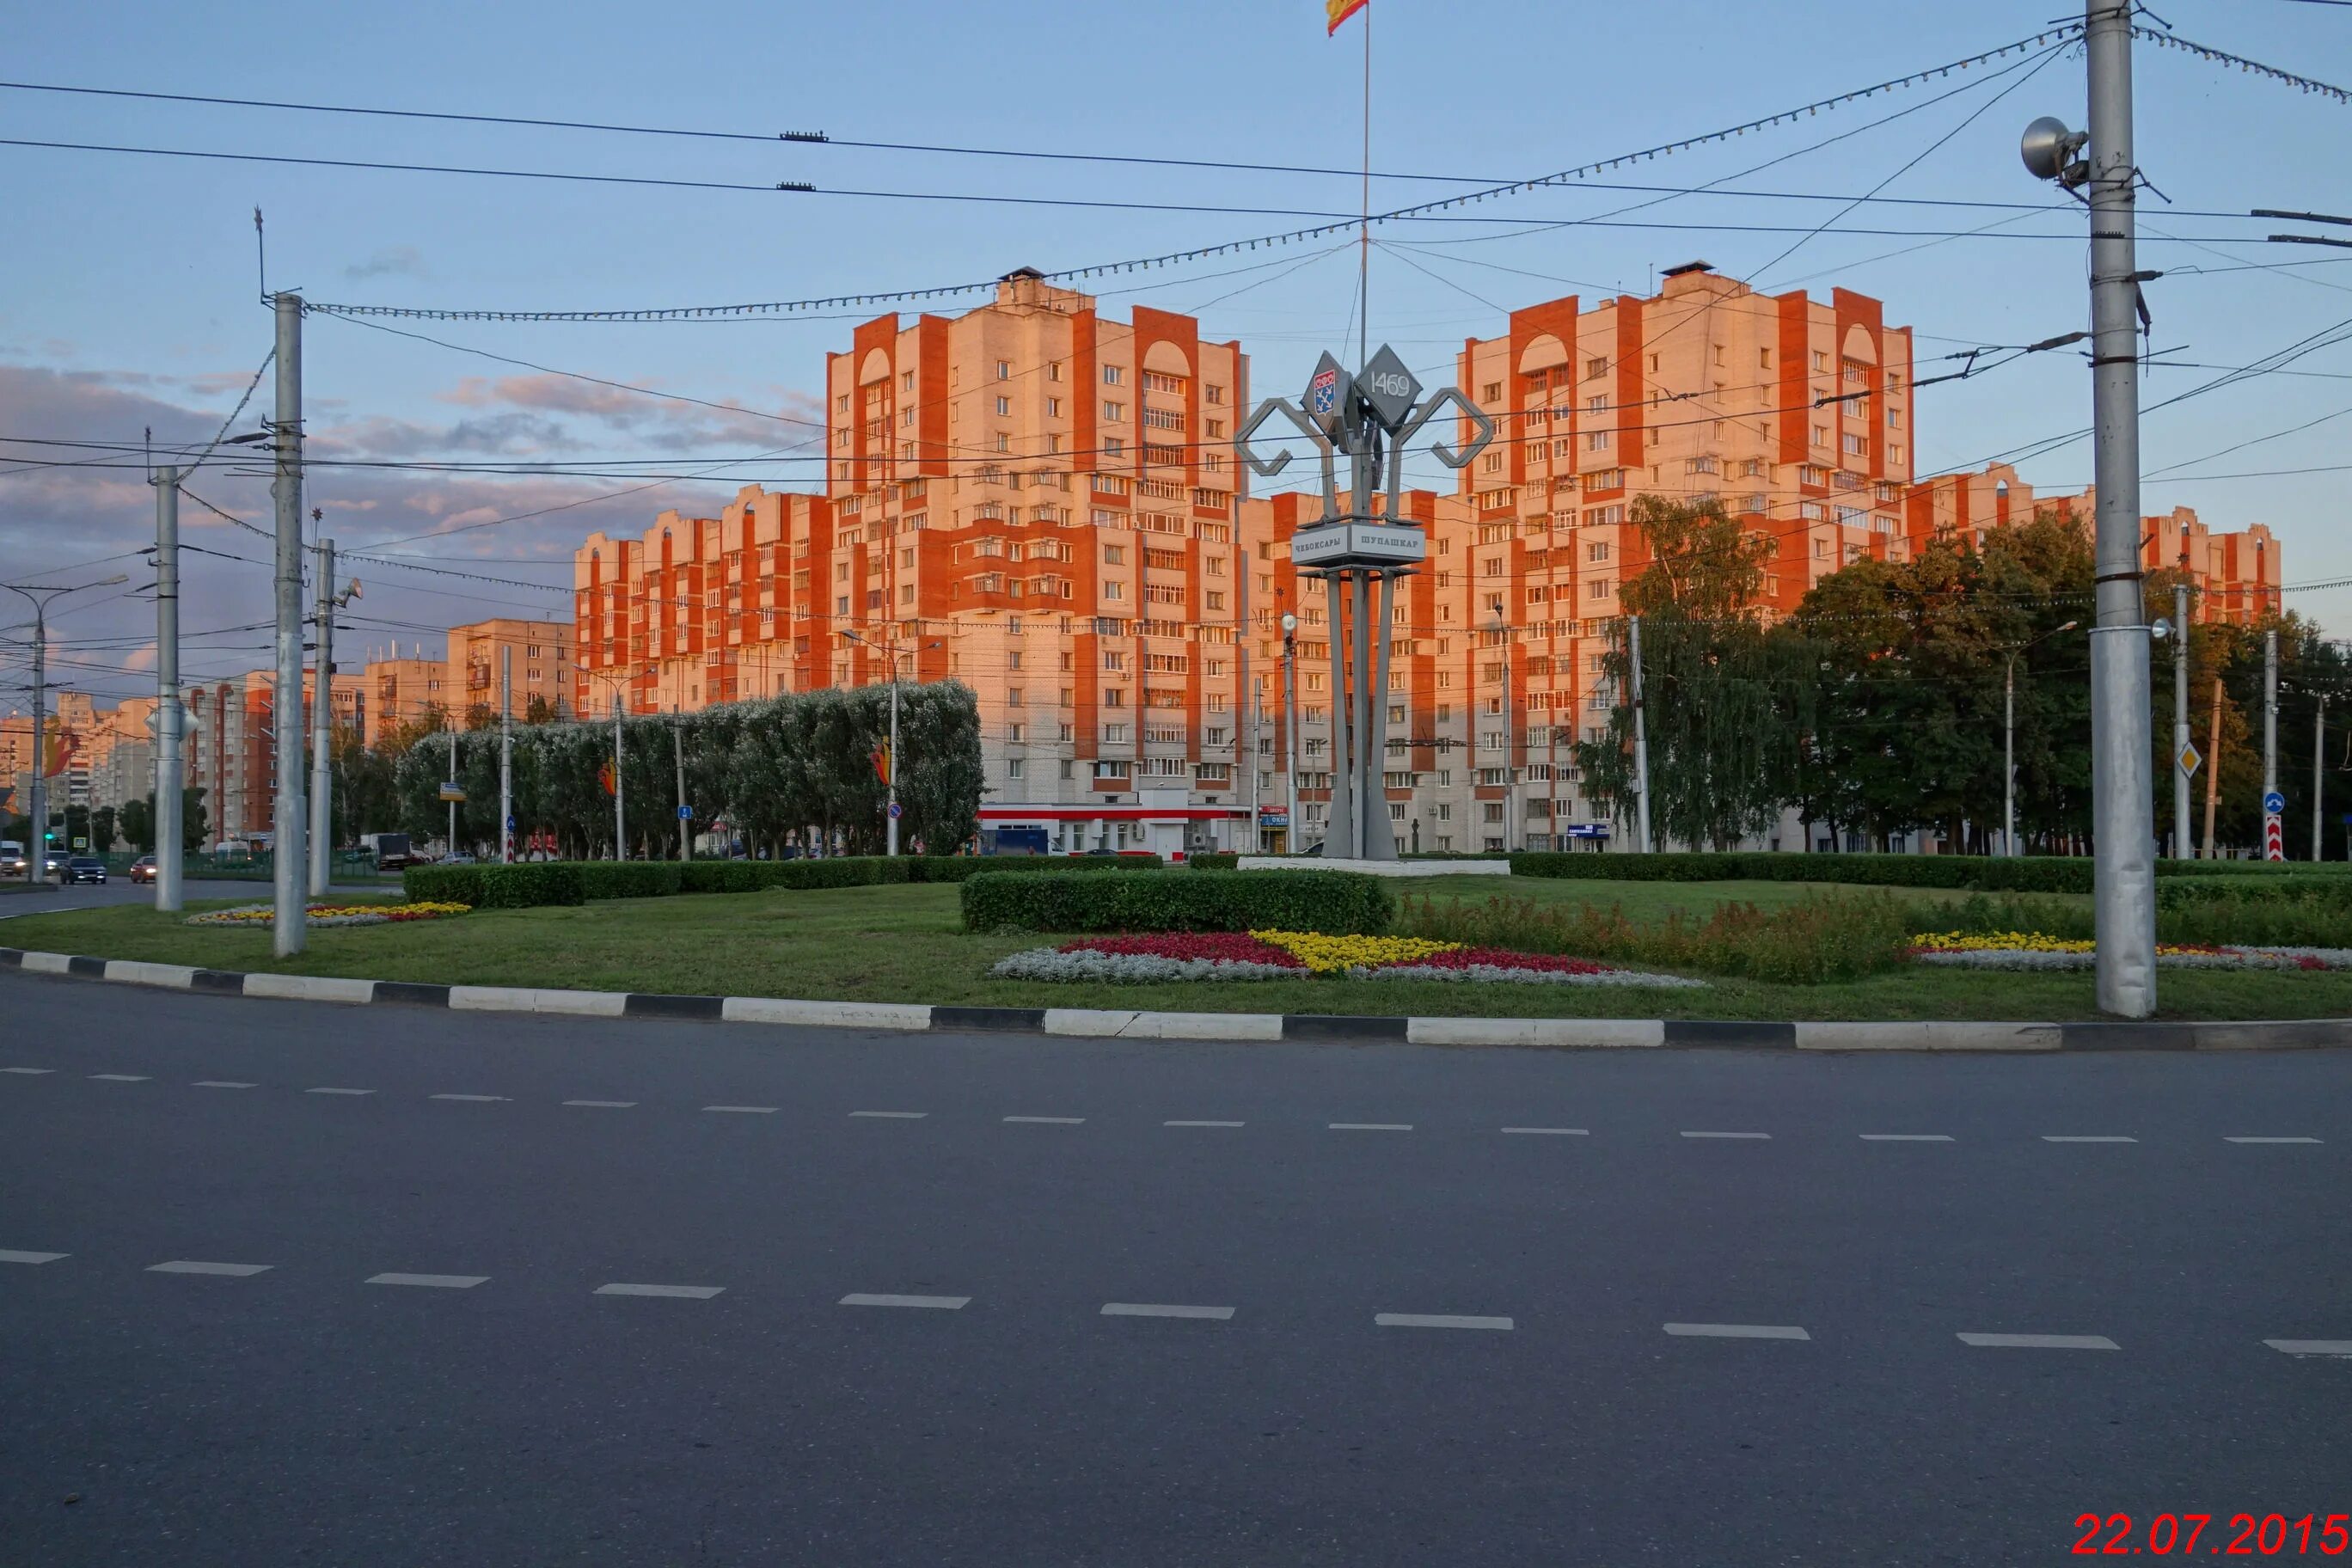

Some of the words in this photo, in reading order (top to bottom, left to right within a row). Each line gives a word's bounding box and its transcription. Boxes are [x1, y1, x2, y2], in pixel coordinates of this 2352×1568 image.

[1371, 371, 1410, 396] 1469
[1295, 537, 1341, 553] ЧЕБОКСАРЫ
[1361, 535, 1418, 548] ШУПАШКАР
